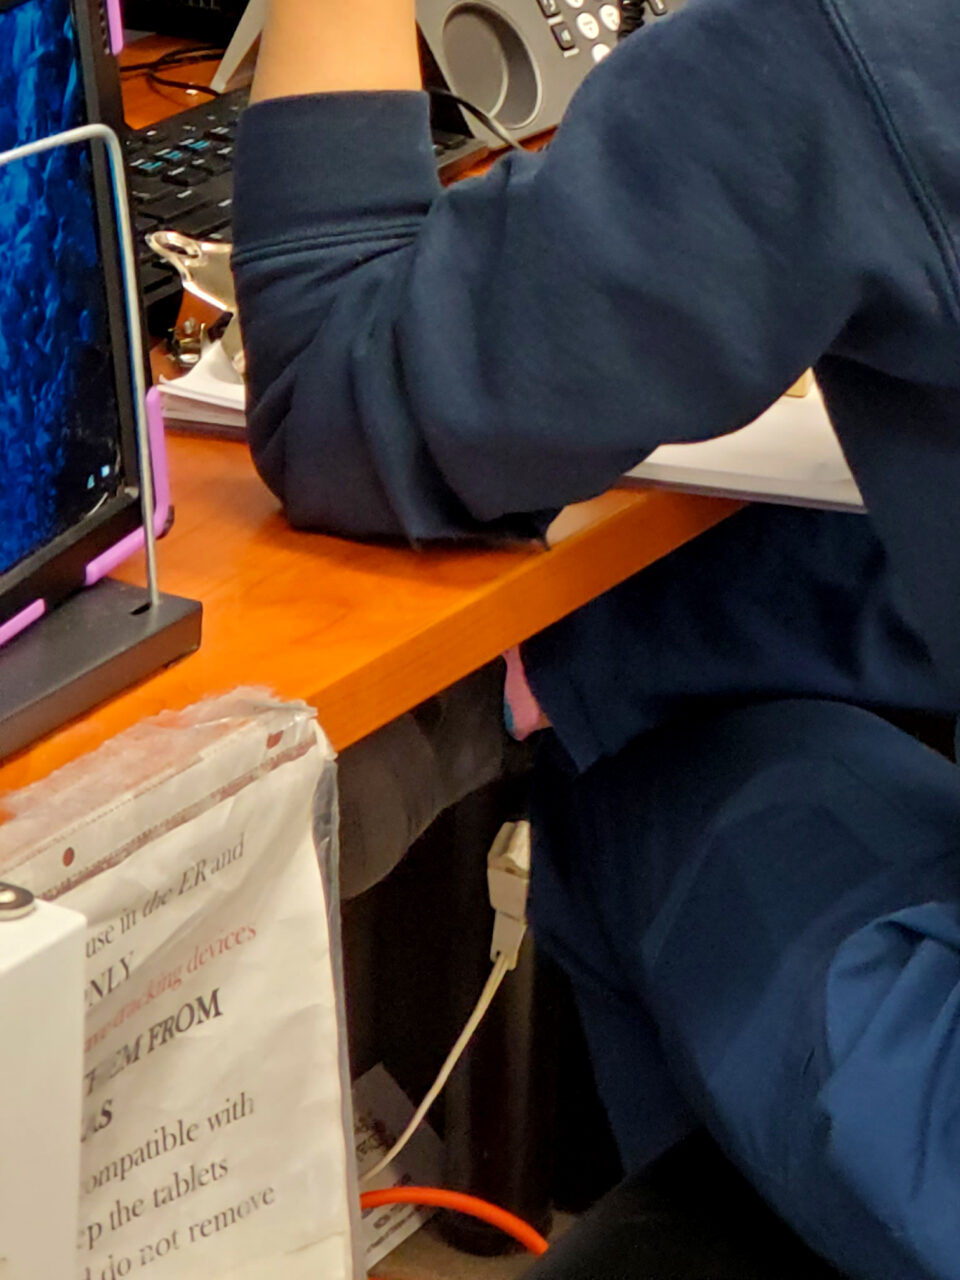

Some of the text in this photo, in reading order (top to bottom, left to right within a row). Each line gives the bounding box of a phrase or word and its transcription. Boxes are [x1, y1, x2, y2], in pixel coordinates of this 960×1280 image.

[86, 831, 245, 959] use in the ER and
[84, 950, 134, 1008] NLY
[186, 922, 258, 974] devices
[147, 986, 223, 1055] FROM
[84, 1091, 256, 1195] ompatible with
[108, 1198, 145, 1232] the
[152, 1157, 229, 1209] tablets
[139, 1229, 181, 1267] not
[188, 1186, 276, 1243] remove
